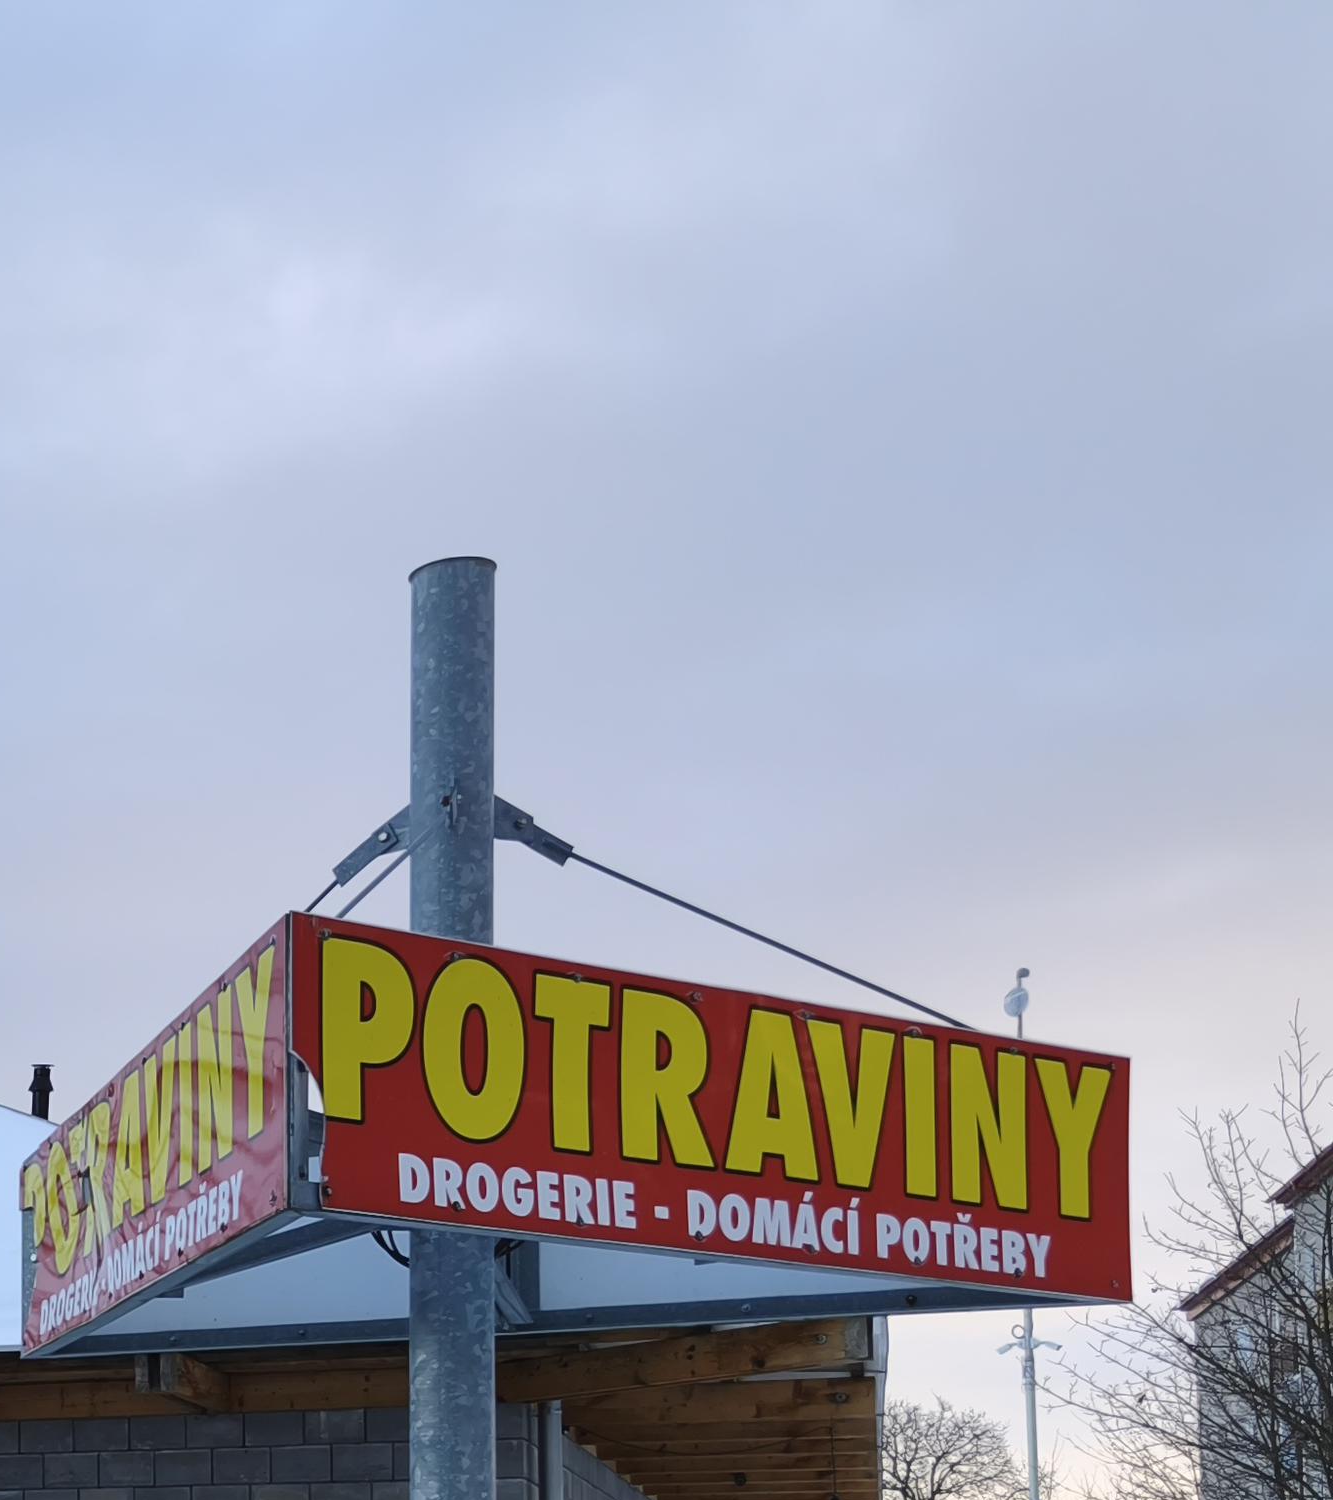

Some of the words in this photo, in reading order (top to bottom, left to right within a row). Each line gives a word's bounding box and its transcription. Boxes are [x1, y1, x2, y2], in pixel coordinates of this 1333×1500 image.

[23, 944, 276, 1277] POTRAVINY
[319, 934, 1113, 1221] POTRAVINY
[107, 1211, 162, 1295] DOMÁCÍ
[164, 1169, 243, 1261] POTŘEBY
[397, 1152, 637, 1230] DROGERIE
[686, 1189, 861, 1256] DOMÁCÍ
[876, 1212, 1051, 1279] POTŘEBY
